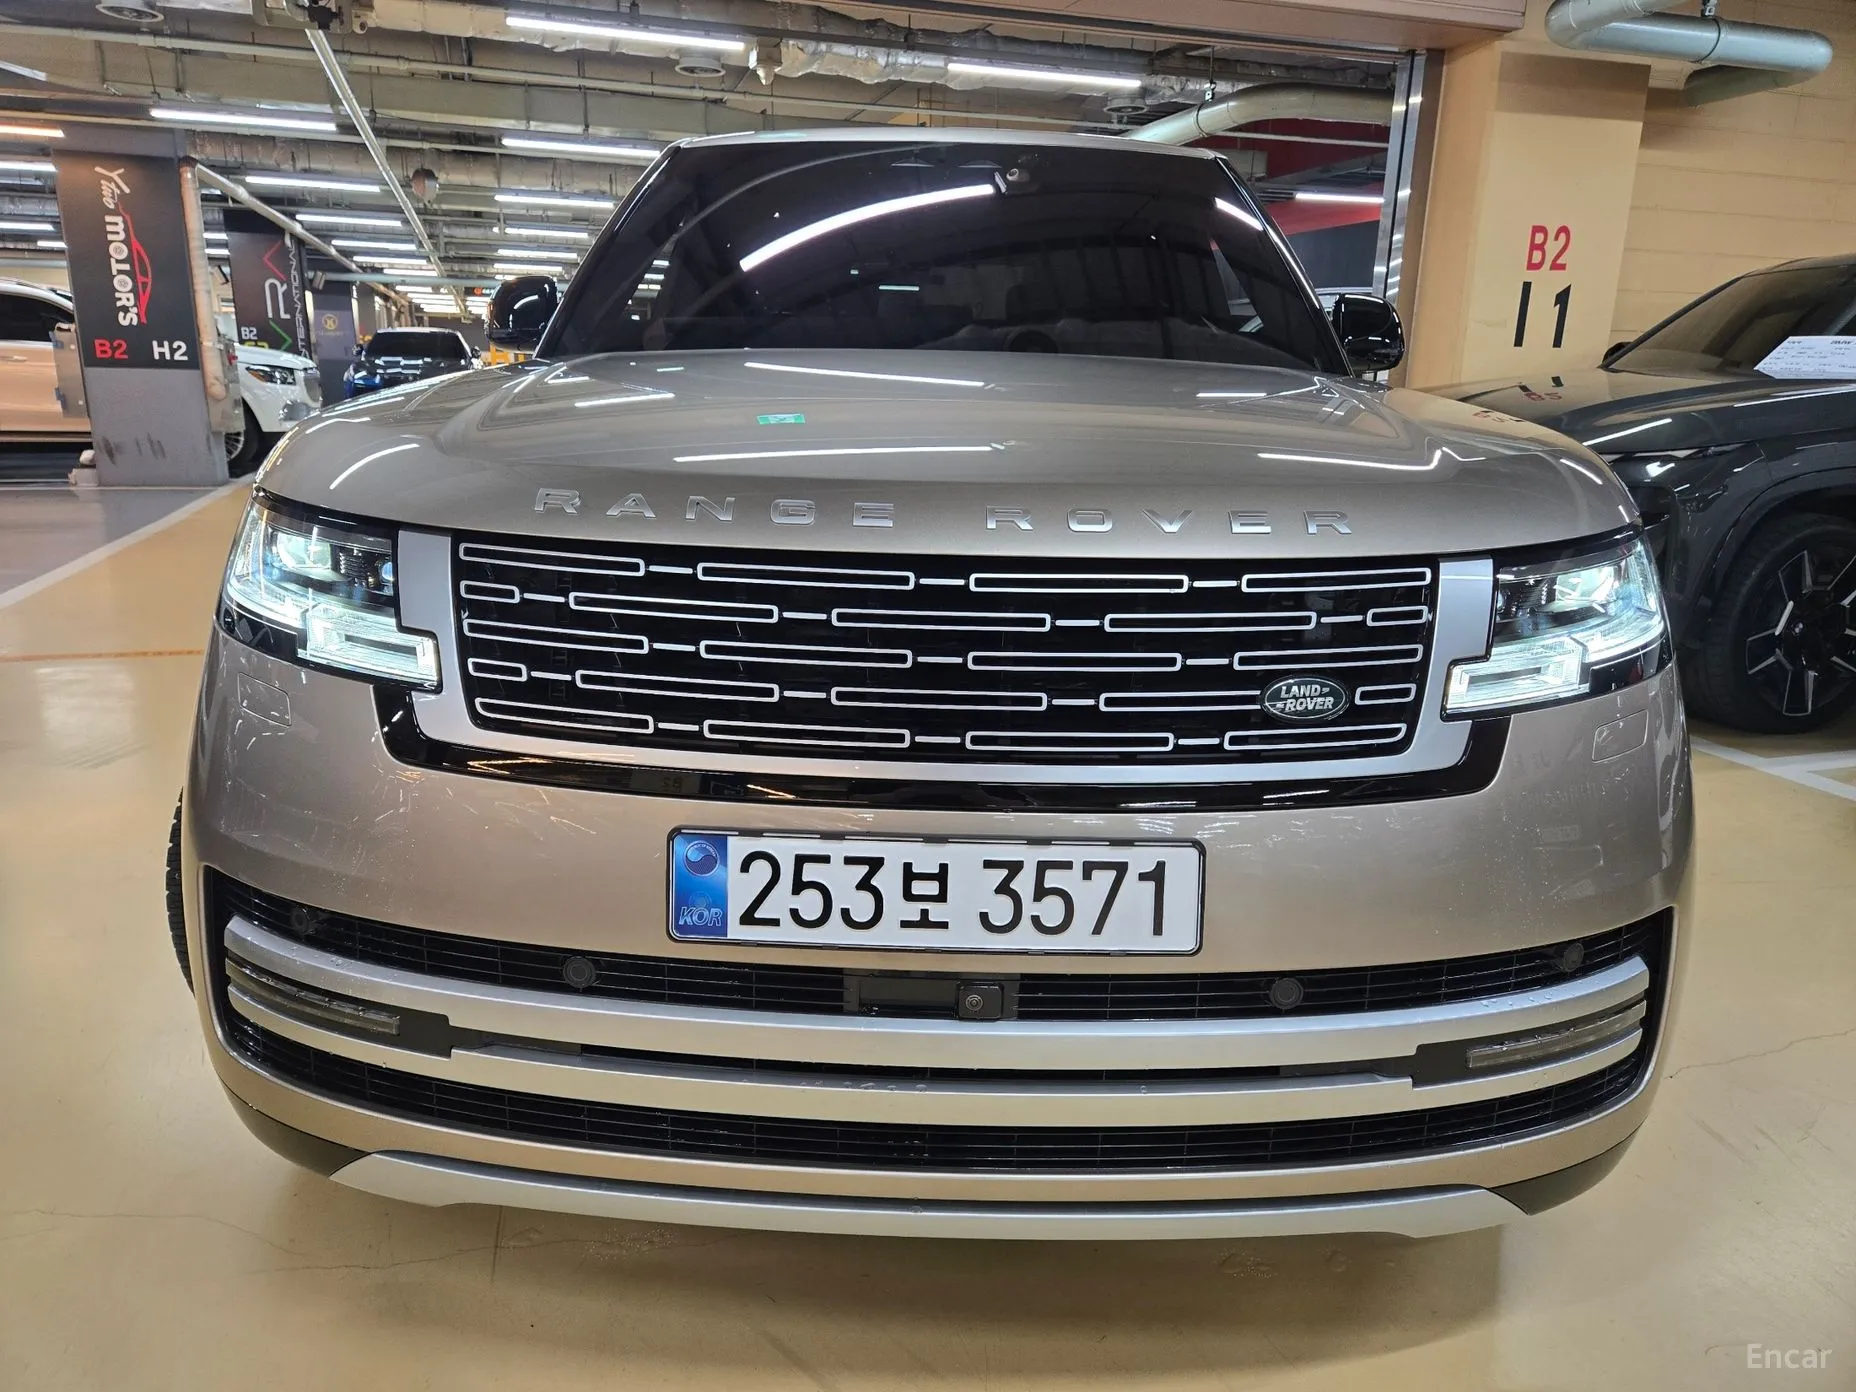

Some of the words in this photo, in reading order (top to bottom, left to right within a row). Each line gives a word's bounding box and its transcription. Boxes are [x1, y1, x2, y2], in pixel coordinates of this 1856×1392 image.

[1526, 225, 1571, 271] B2
[241, 327, 258, 340] B2
[94, 339, 128, 359] B2
[152, 340, 188, 360] H2
[534, 487, 894, 528] RANGE
[985, 505, 1352, 535] ROVER
[1280, 685, 1321, 699] LAND
[1284, 696, 1334, 713] ROVER
[739, 850, 949, 930] 253보
[978, 859, 1166, 935] 3571
[679, 906, 723, 927] KOR
